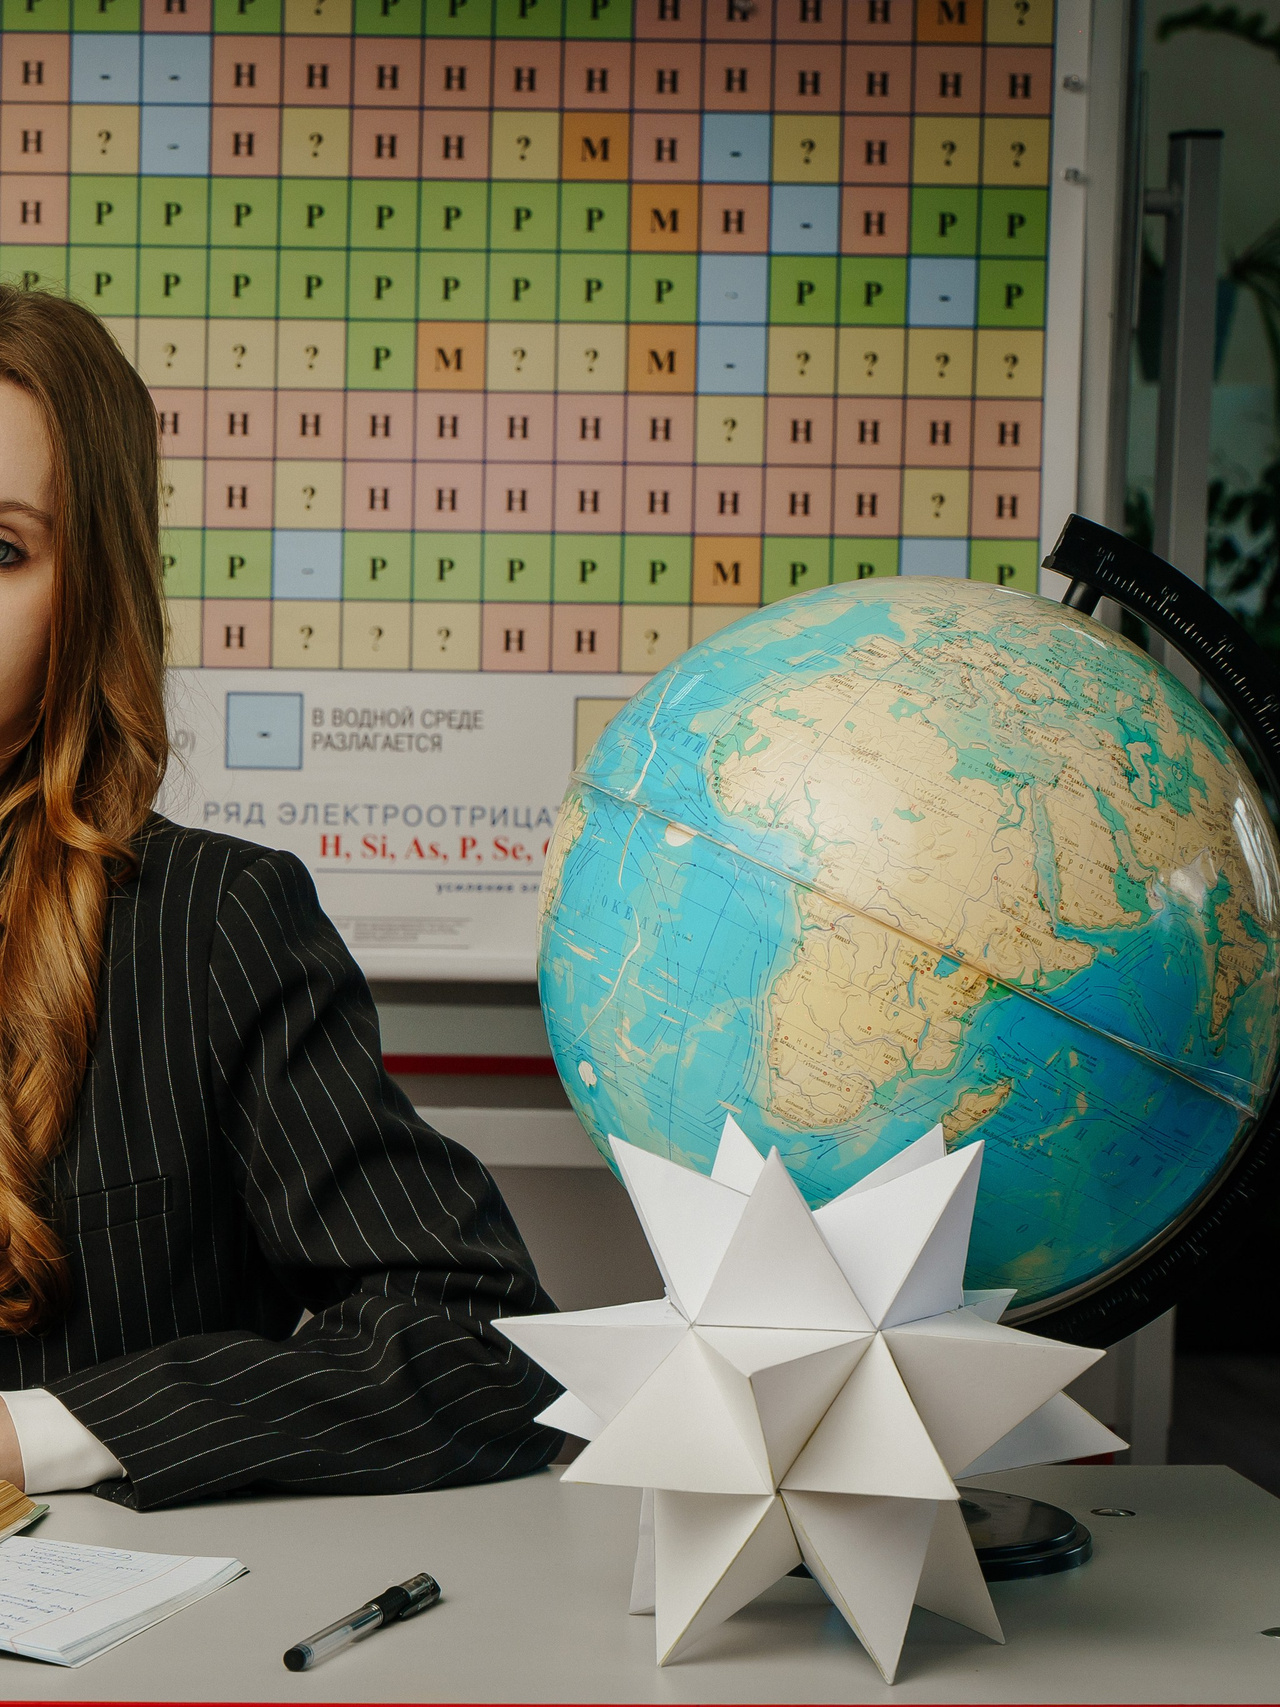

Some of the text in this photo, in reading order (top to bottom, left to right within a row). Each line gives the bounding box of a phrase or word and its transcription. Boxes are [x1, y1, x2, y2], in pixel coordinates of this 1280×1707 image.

[202, 801, 266, 829] РЯД
[320, 834, 532, 864] H, Si, As, P, Se,
